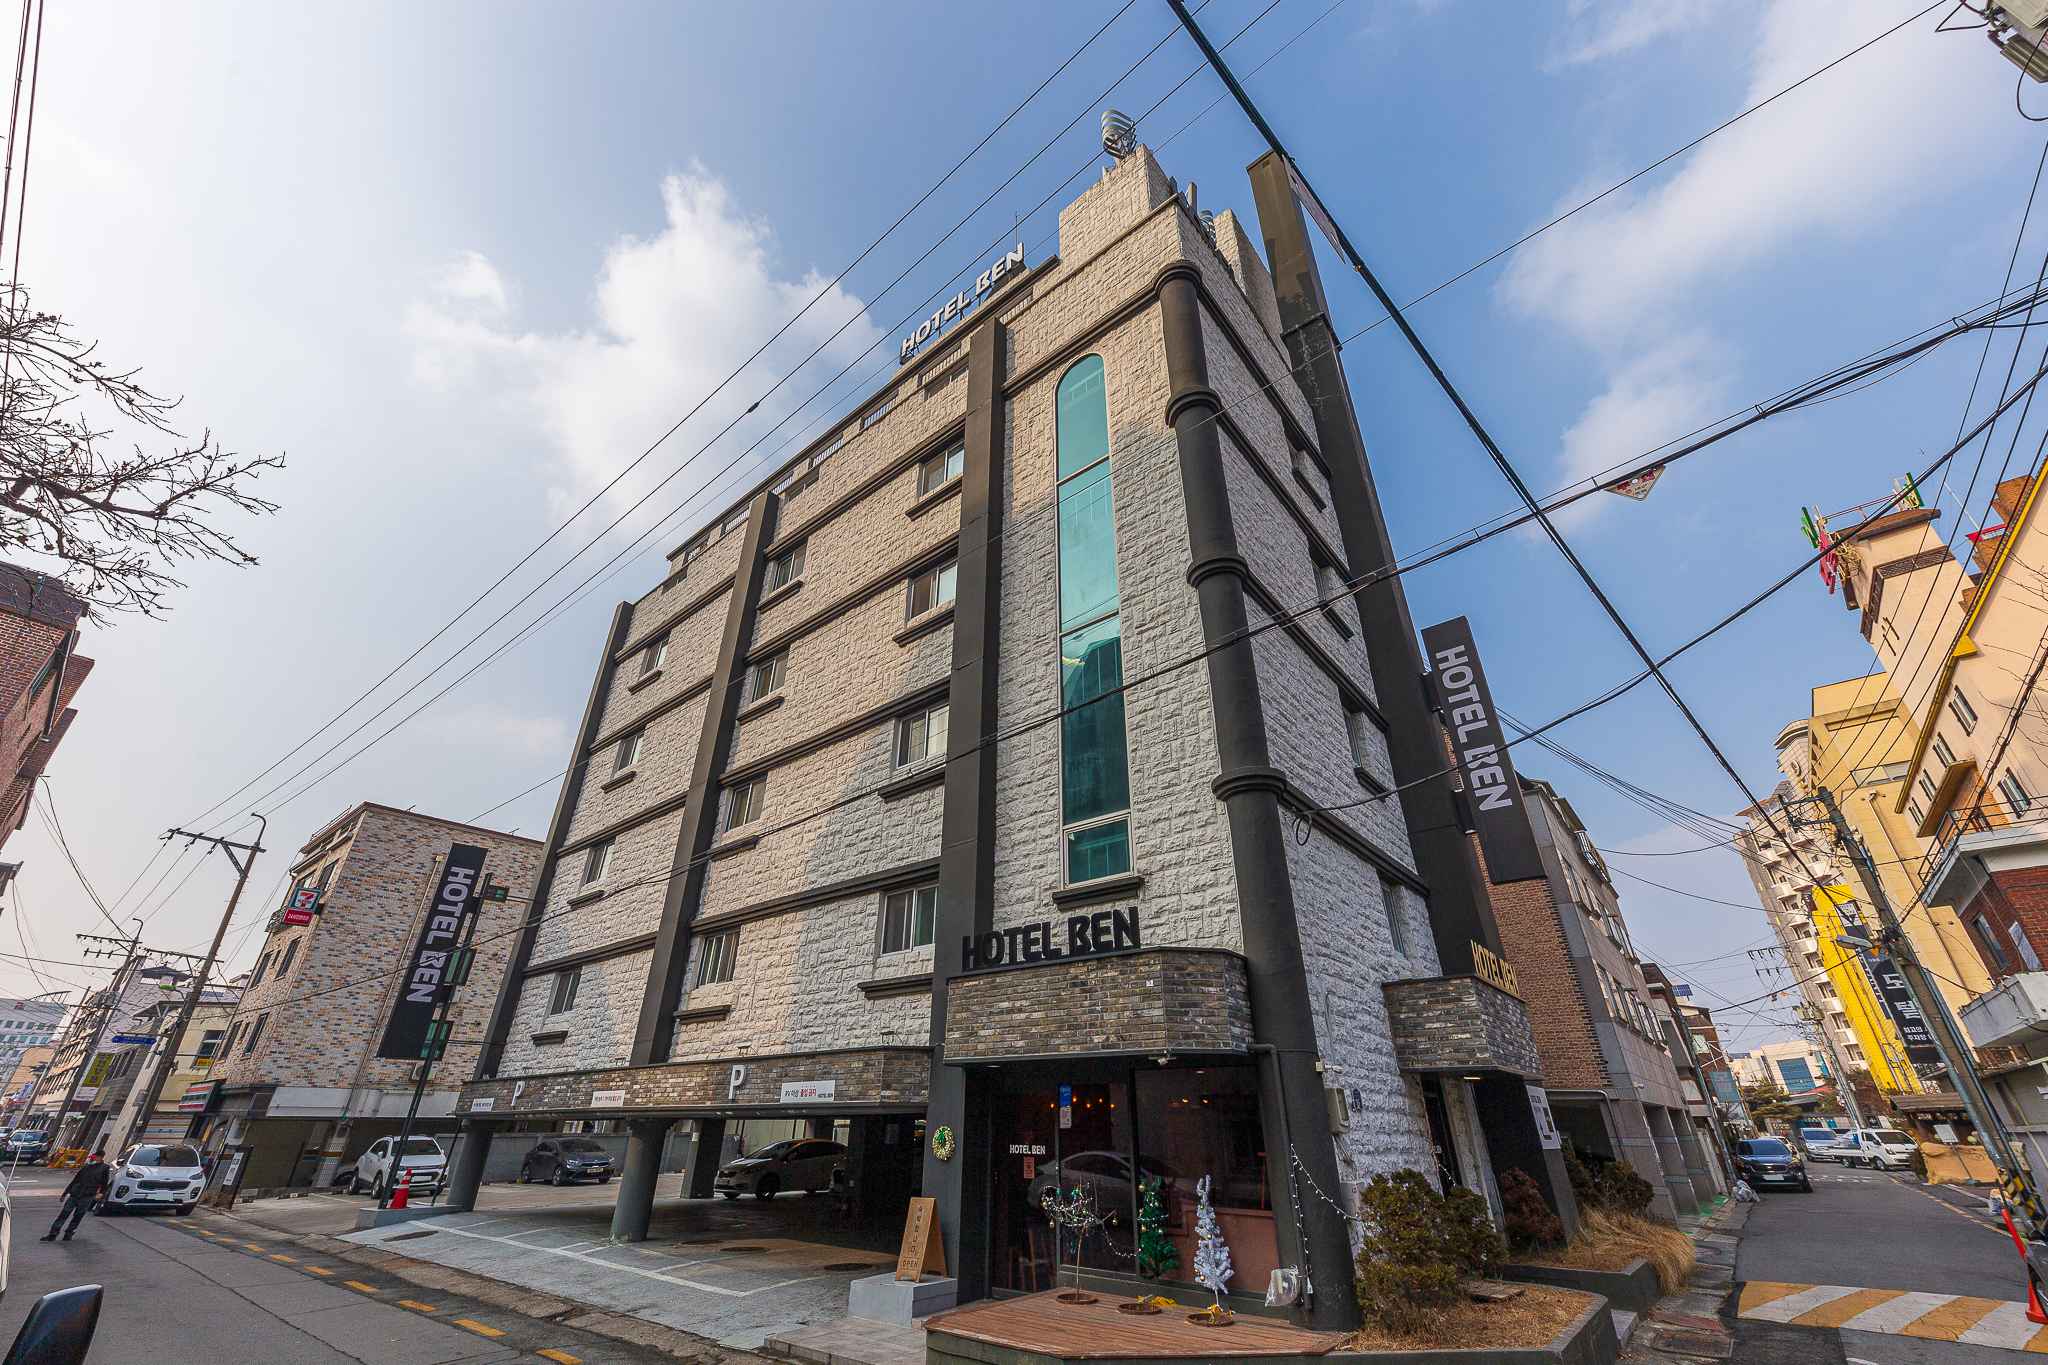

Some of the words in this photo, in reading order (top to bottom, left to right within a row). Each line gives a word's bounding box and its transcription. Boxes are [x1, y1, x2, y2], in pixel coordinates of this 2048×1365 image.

[901, 291, 971, 357] HOTEL
[976, 242, 1024, 296] BEN
[1435, 645, 1489, 744] HOTEL
[1463, 744, 1513, 811] BEN
[426, 866, 475, 945] HOTEL
[962, 922, 1063, 973] HOTEL
[1068, 906, 1141, 958] BEN
[406, 950, 446, 1003] BEN
[1471, 939, 1501, 985] HOTEL
[1500, 958, 1520, 995] BEN
[511, 1081, 525, 1106] P
[729, 1065, 747, 1099] P
[1010, 1144, 1031, 1154] HOTEL
[1031, 1145, 1046, 1155] BEN
[902, 1260, 918, 1268] OPEN
